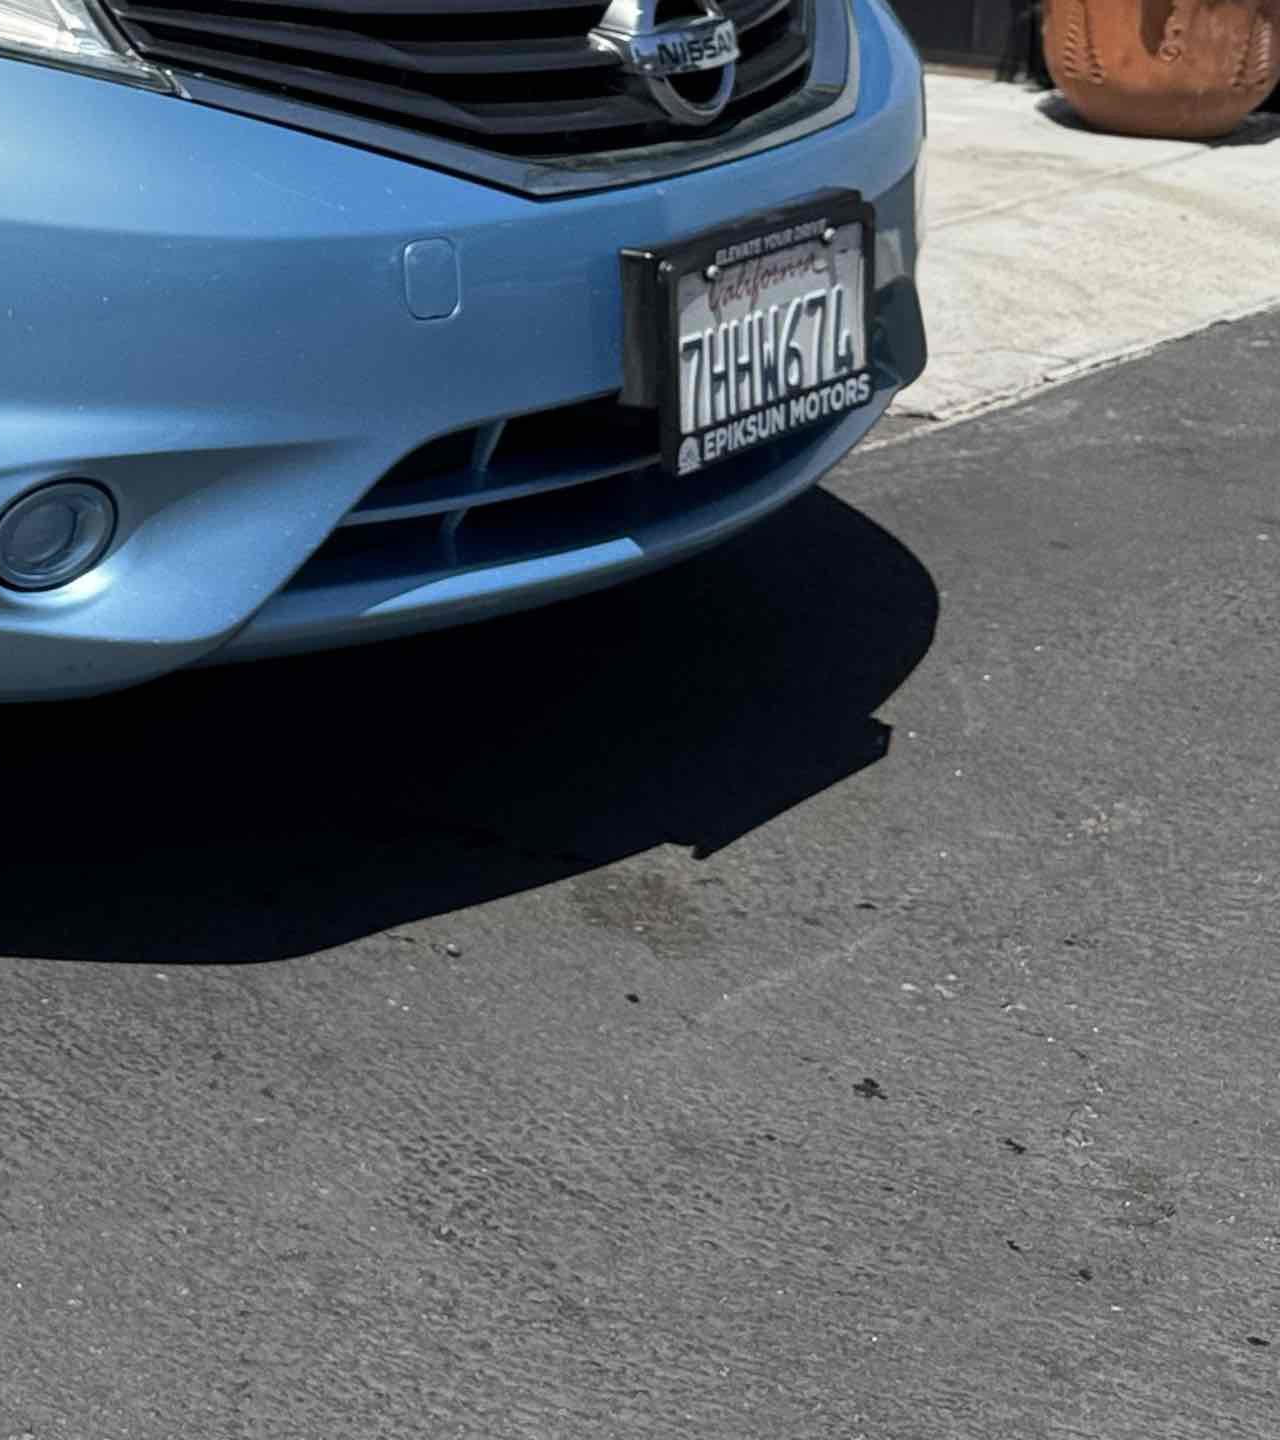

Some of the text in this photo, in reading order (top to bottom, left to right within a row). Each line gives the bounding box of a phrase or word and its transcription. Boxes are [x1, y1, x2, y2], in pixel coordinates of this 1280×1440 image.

[656, 27, 732, 65] NISSAN
[715, 236, 761, 265] ELEVATE
[764, 228, 792, 250] YOUR
[707, 252, 828, 311] California
[679, 284, 853, 435] 7HHW674
[703, 372, 871, 462] EPIKSUN MOTORS
